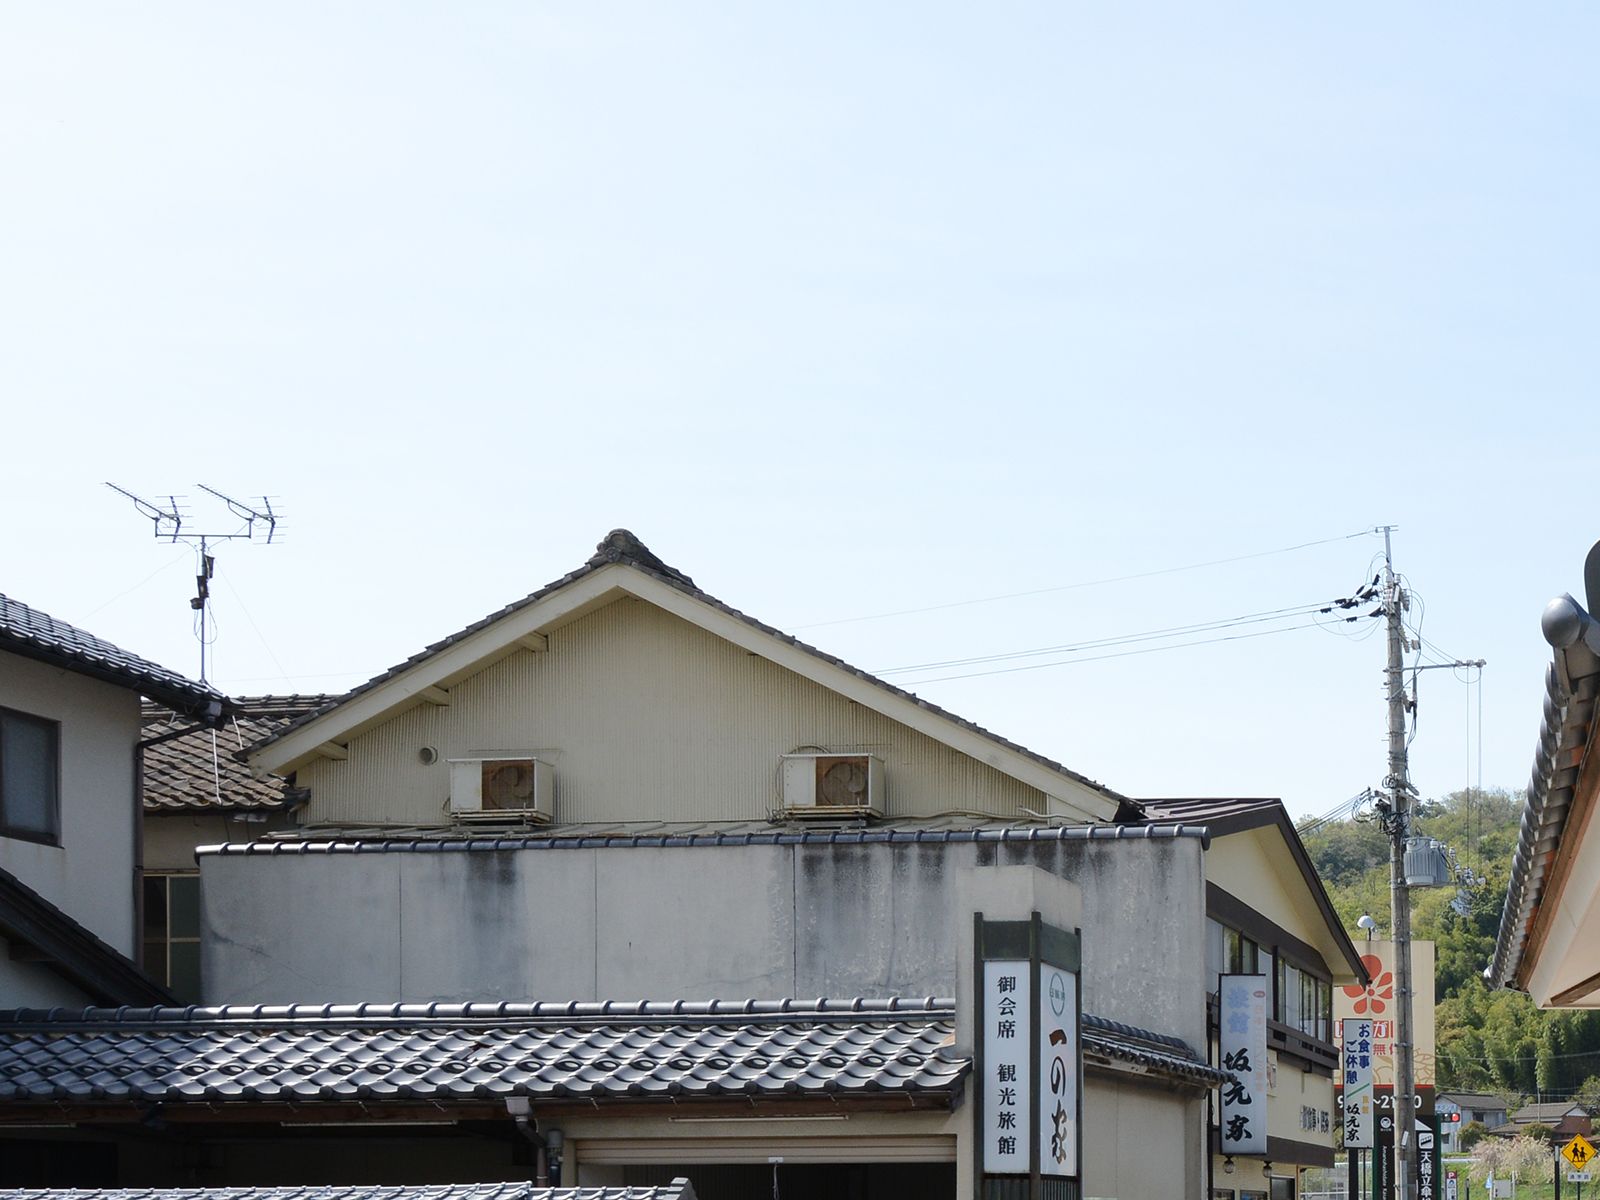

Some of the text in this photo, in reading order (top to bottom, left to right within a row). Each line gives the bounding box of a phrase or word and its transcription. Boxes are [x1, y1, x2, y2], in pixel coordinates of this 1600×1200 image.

[997, 976, 1016, 1155] 御会席 観光旅館
[1346, 1039, 1358, 1084] ご休憩
[1358, 1024, 1370, 1069] お食事
[1223, 1047, 1252, 1143] 坂元家
[1346, 1103, 1360, 1142] 坂元家
